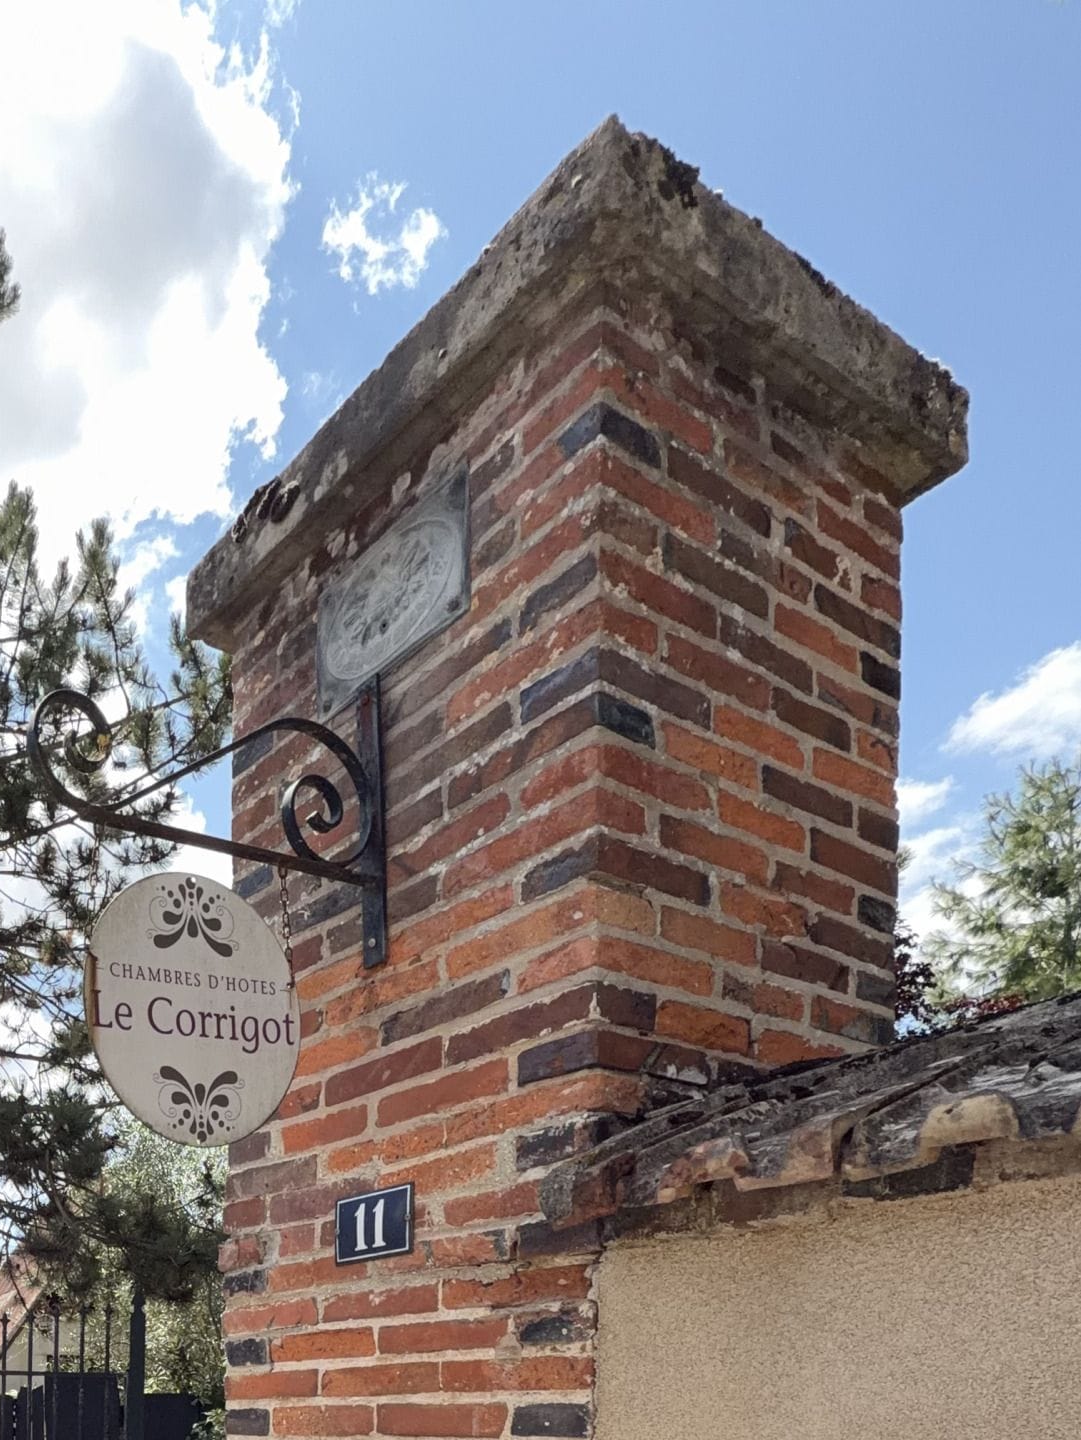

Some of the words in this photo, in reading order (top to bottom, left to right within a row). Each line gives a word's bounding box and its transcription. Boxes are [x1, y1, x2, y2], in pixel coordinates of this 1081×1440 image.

[109, 961, 201, 988] CHAMBRES
[207, 974, 277, 996] D'HOTES
[92, 990, 133, 1031] Le
[146, 996, 295, 1054] Corrigot
[354, 1198, 387, 1252] 11
